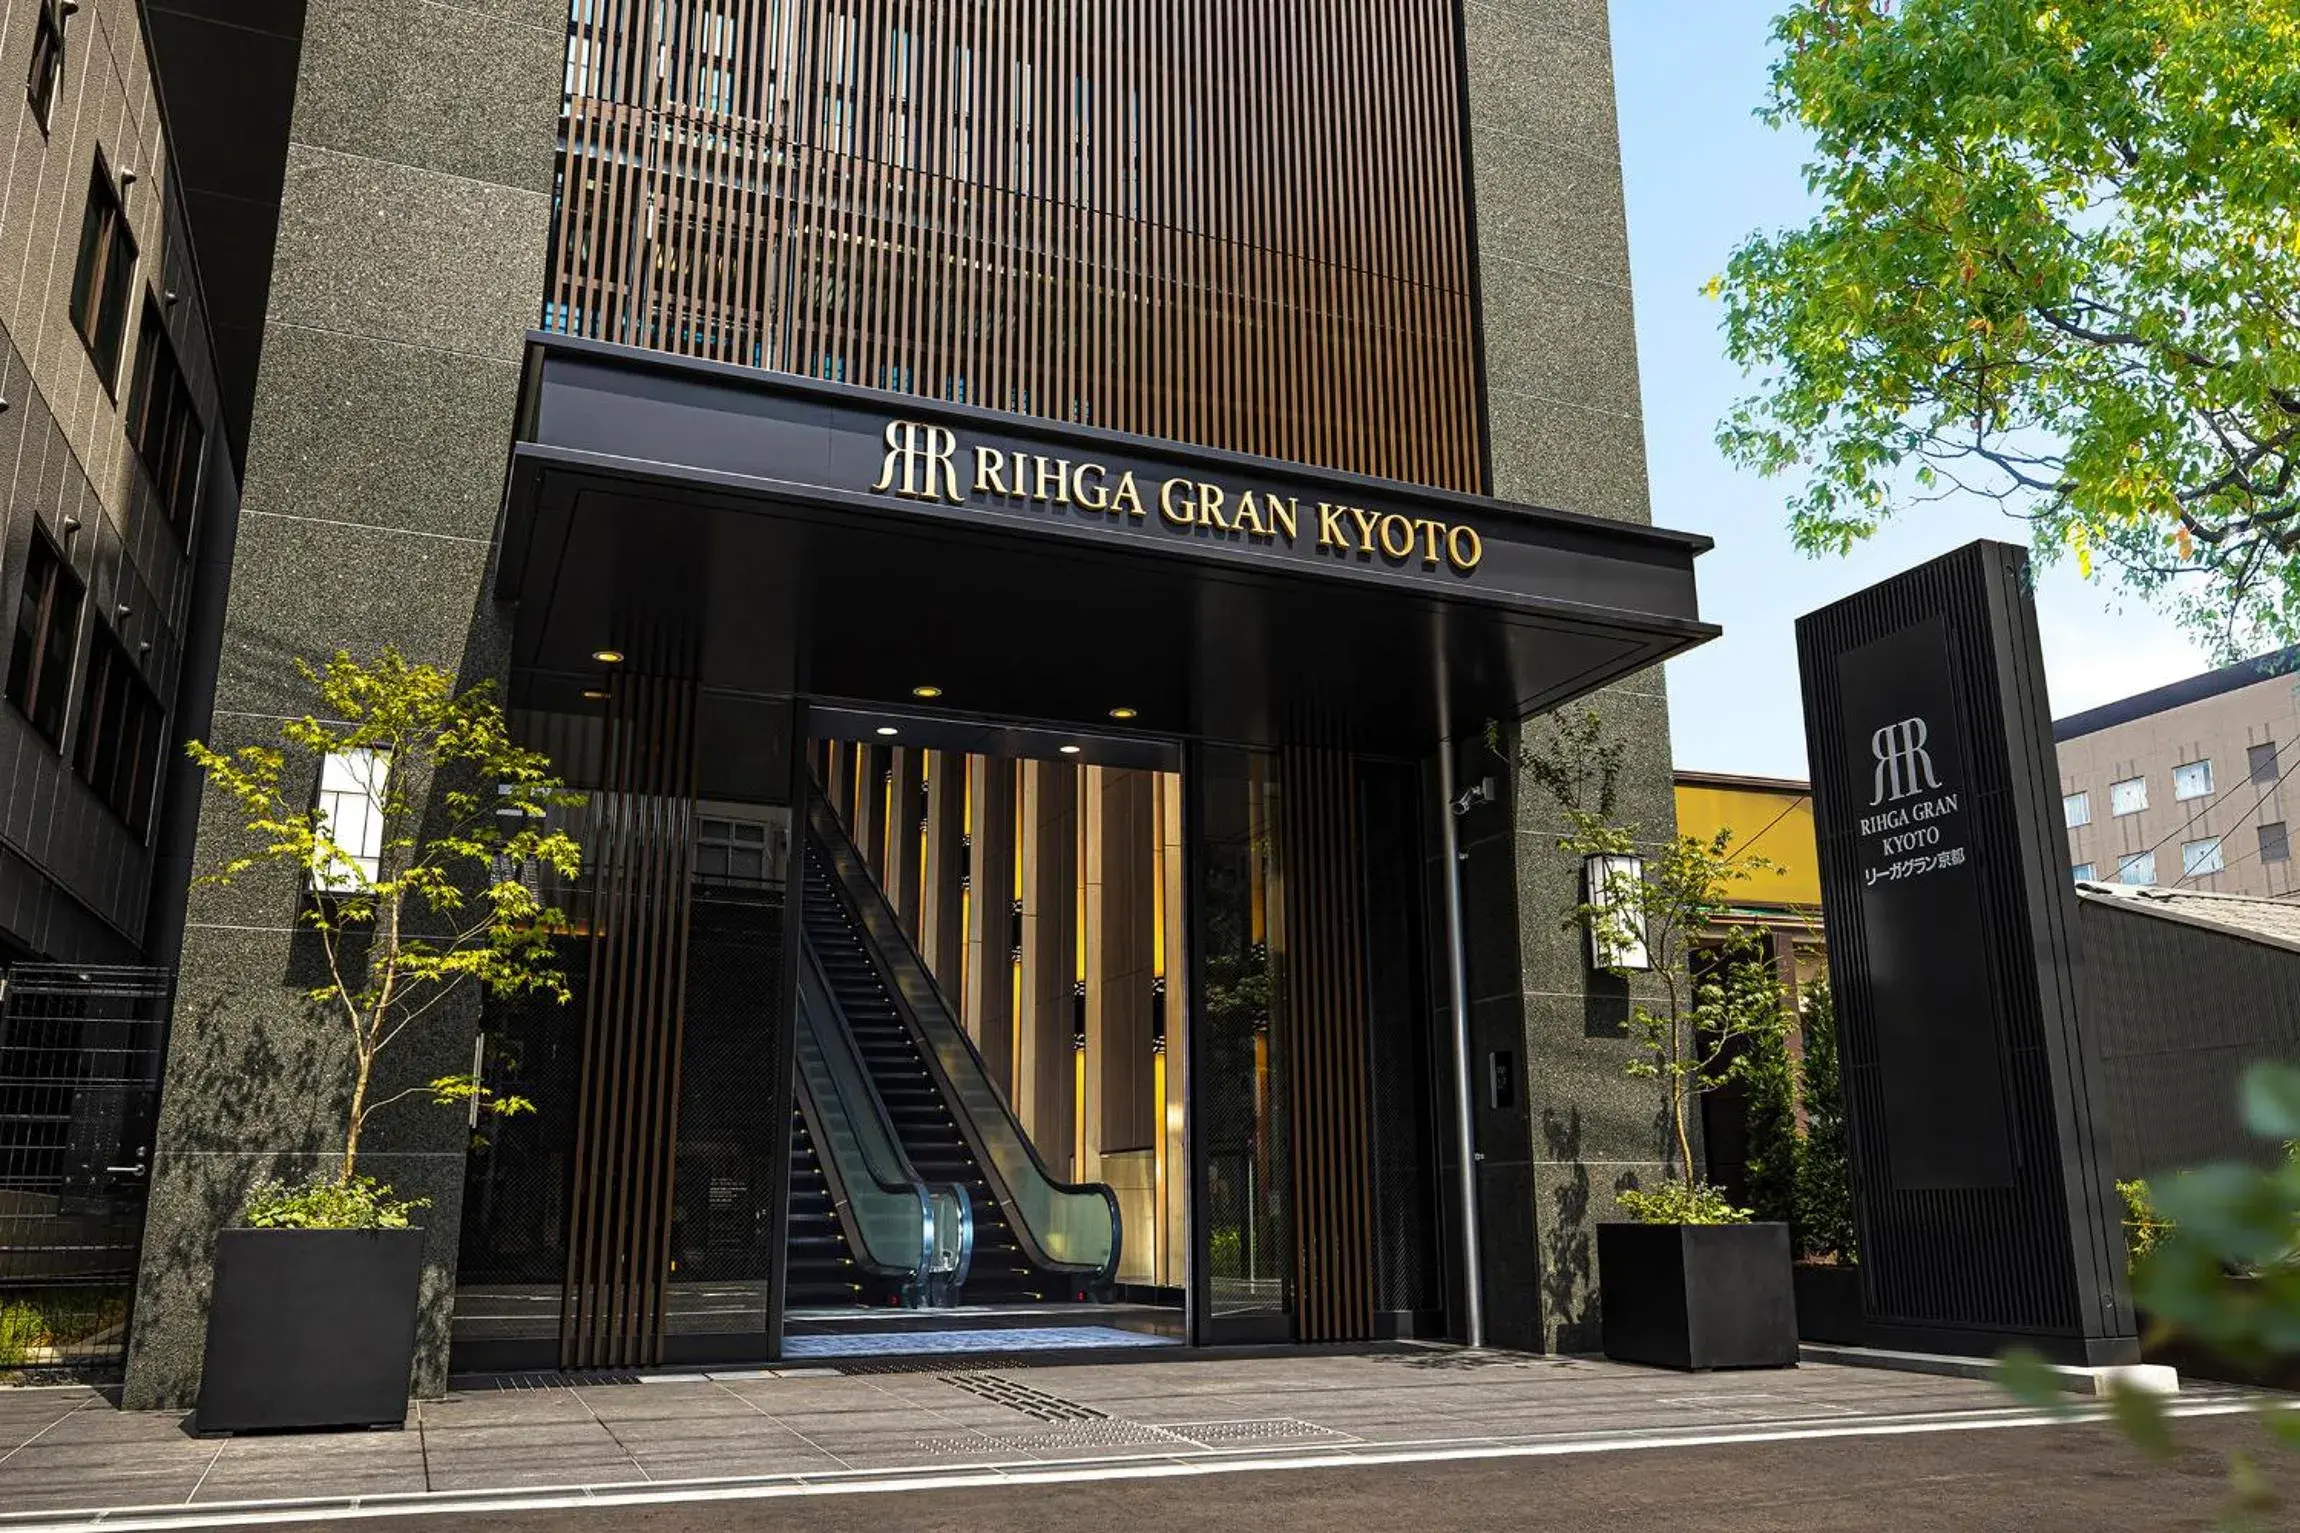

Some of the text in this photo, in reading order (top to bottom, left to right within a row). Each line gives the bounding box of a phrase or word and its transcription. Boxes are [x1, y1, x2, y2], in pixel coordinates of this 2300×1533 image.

[972, 445, 1147, 516] RIHGA
[1159, 478, 1299, 540] GRAN
[1317, 502, 1483, 571] KYOTO
[1860, 793, 1959, 836] RIHGA GRAN
[1882, 826, 1940, 857] KYOTO
[1865, 847, 1966, 886] リーガグラン京都
